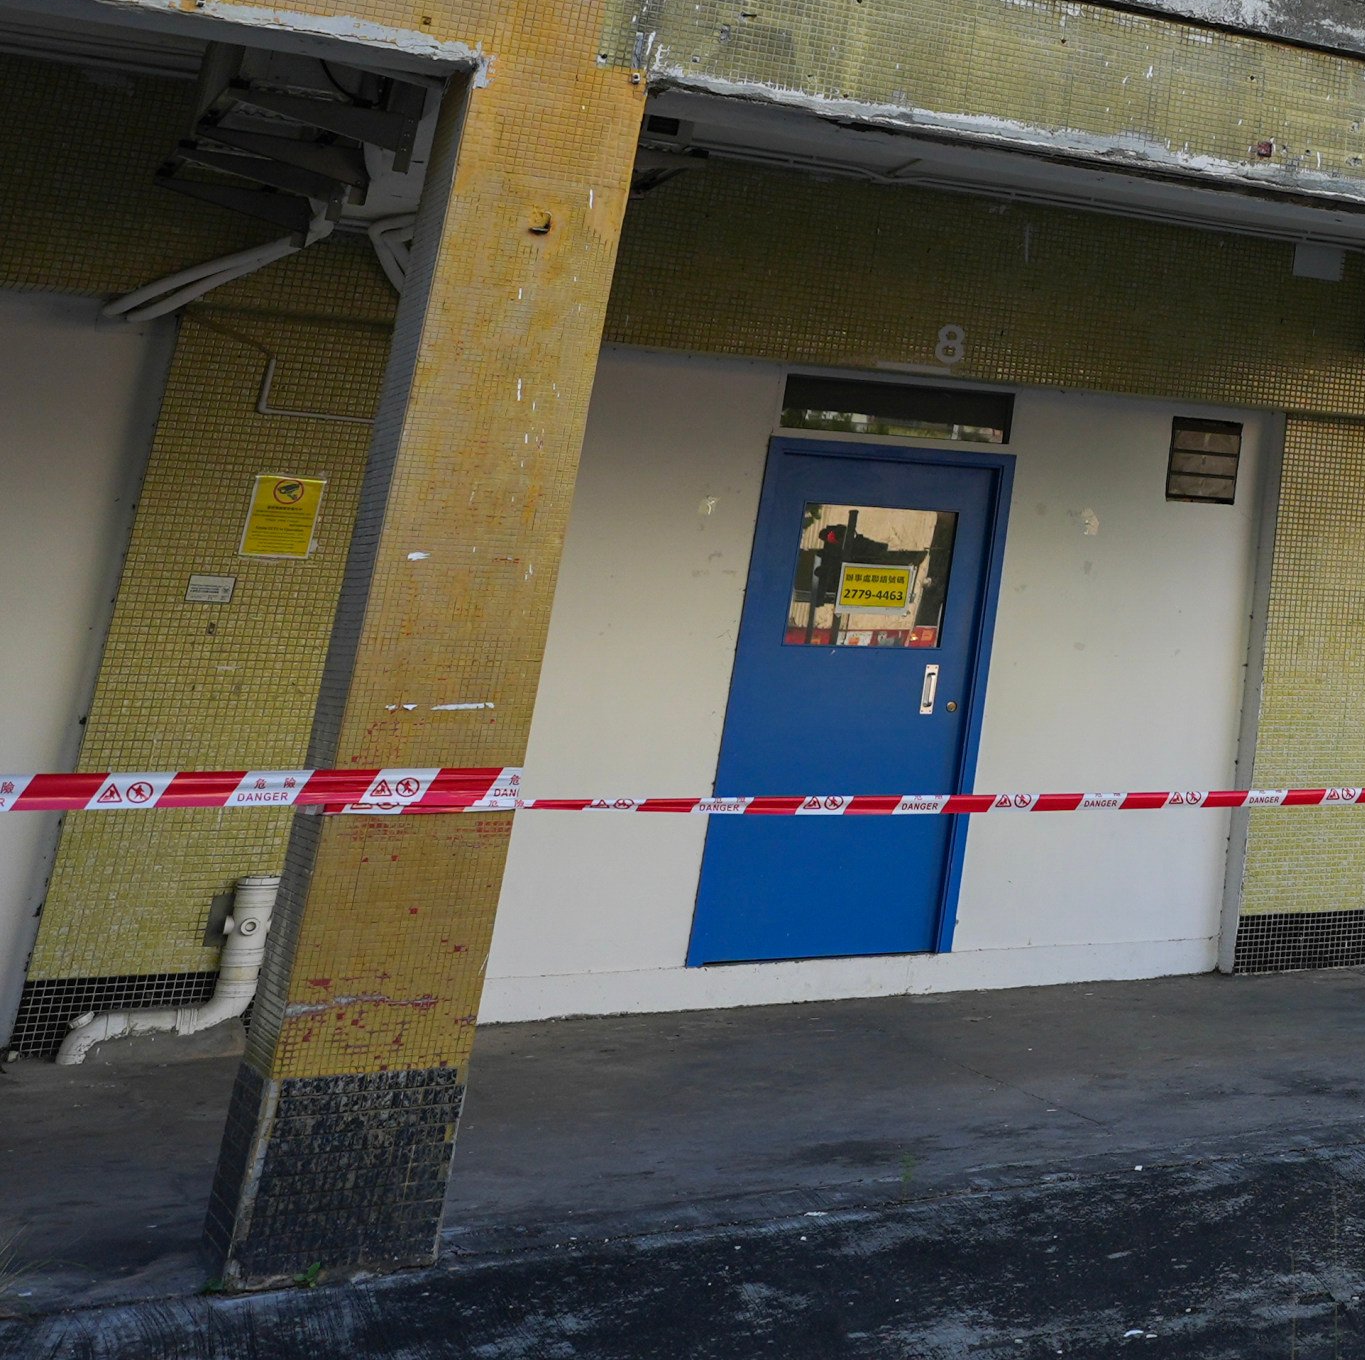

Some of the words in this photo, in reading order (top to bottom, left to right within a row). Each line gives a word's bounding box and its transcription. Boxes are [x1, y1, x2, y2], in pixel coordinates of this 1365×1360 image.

[935, 323, 966, 364] 8
[843, 588, 903, 601] 2779-4463
[237, 792, 288, 803] DANGER
[1249, 796, 1280, 804] DANGER
[699, 804, 740, 812] DANGER
[901, 802, 939, 811] DANGER
[1083, 799, 1118, 808] DANGER
